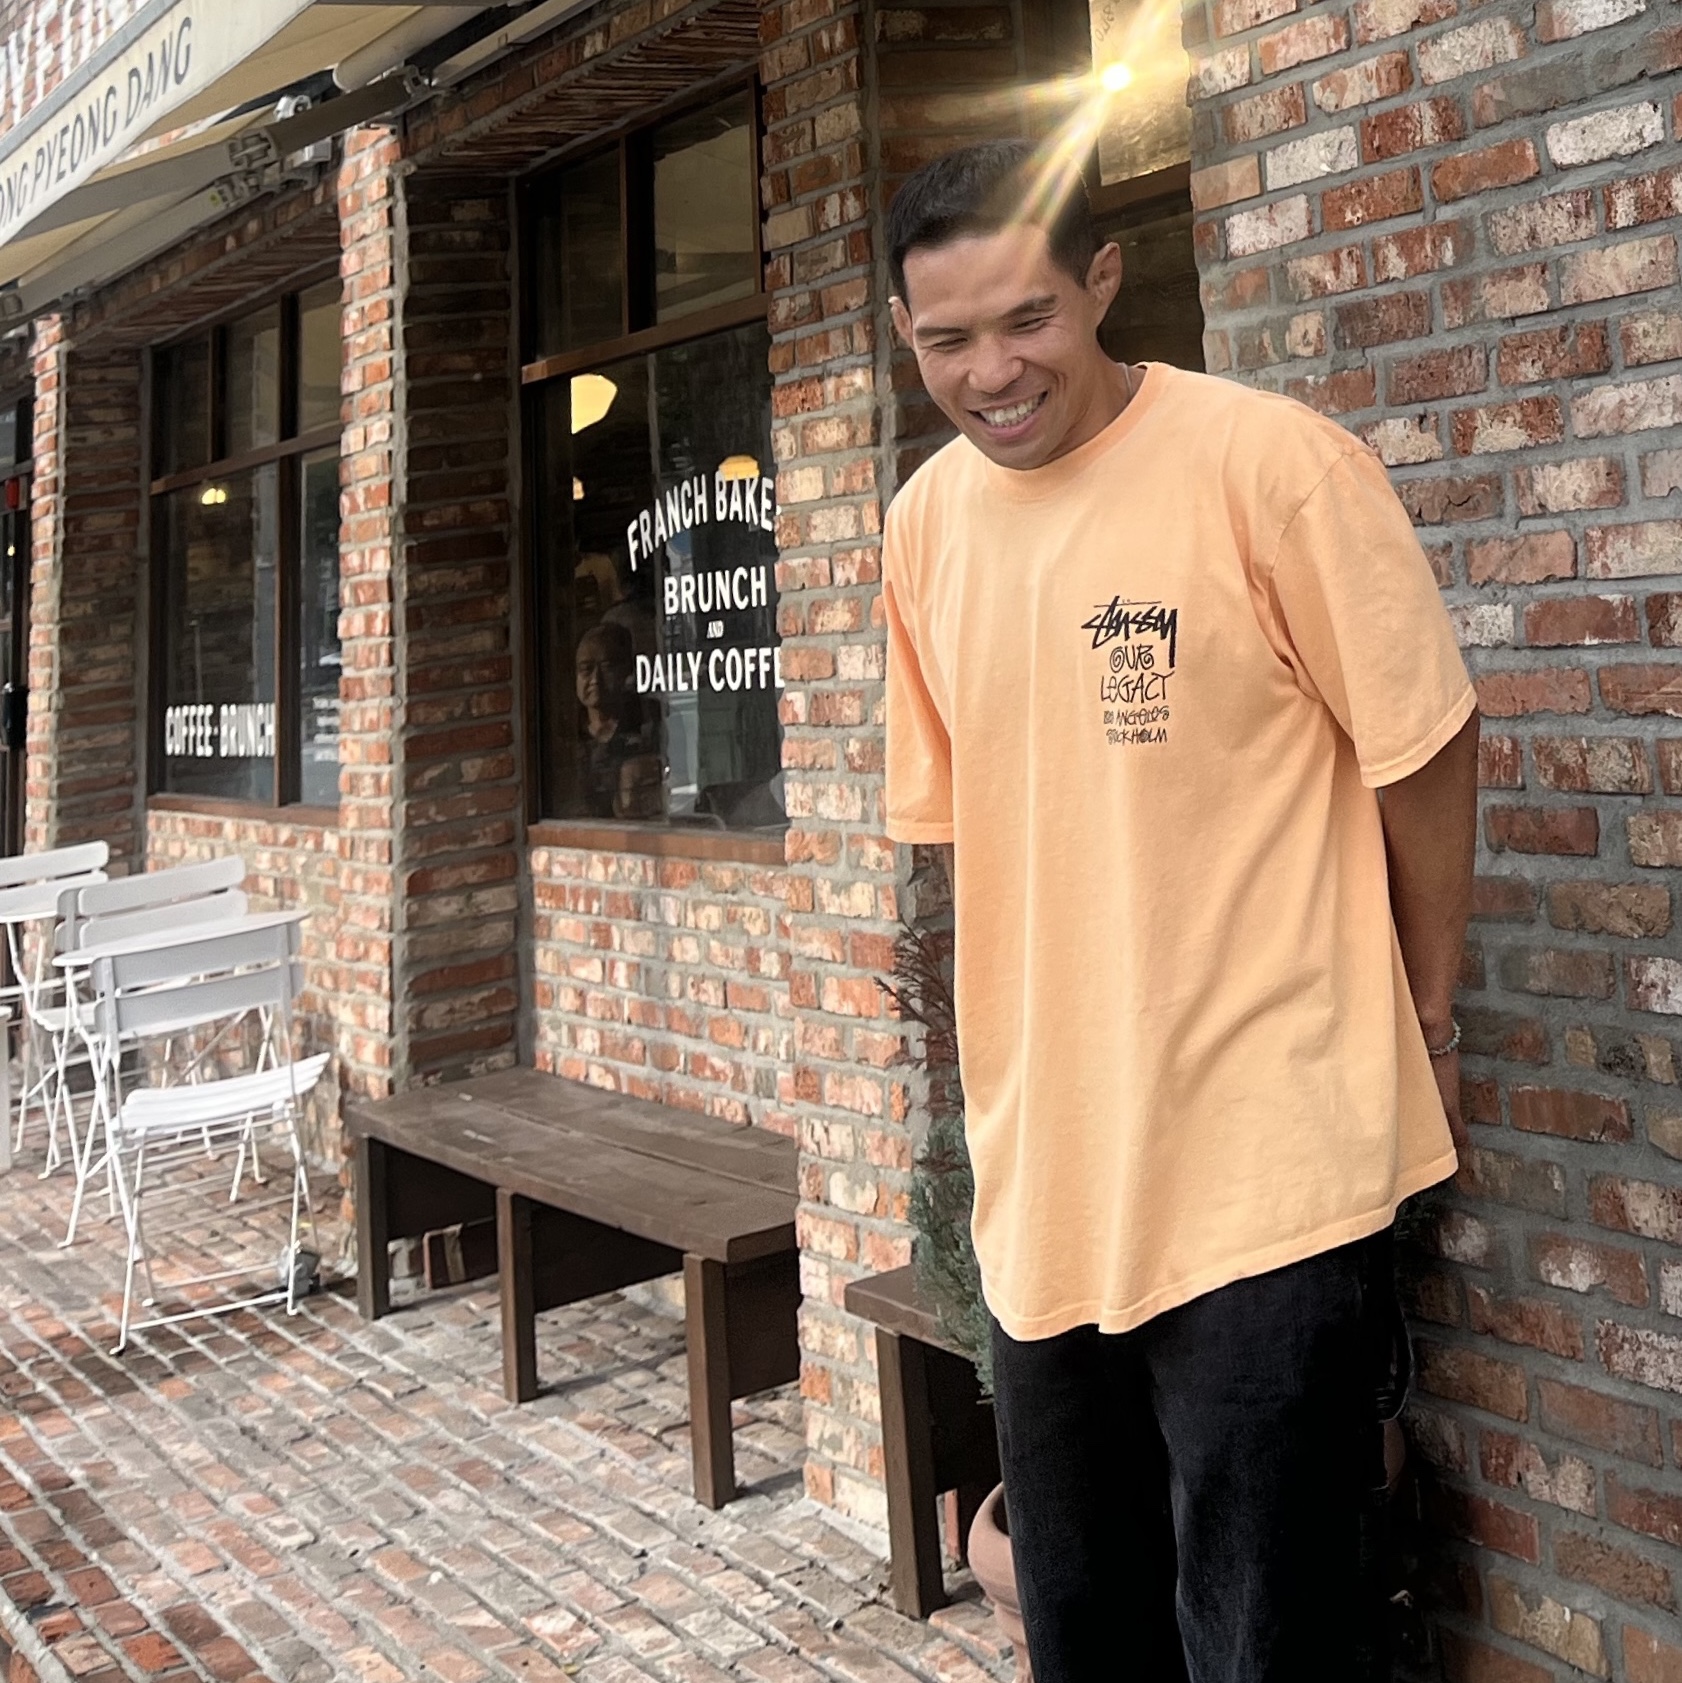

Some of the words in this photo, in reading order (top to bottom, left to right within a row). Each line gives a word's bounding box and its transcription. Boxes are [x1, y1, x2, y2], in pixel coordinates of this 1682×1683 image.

[30, 85, 118, 204] PYEONG
[125, 16, 192, 131] DANG
[627, 473, 708, 572] FRANCH
[714, 471, 781, 532] BAKE
[664, 565, 767, 615] BRUNCH
[707, 620, 724, 638] AND
[636, 651, 702, 693] DAILY
[1109, 643, 1154, 674] OUR
[1101, 671, 1175, 703] LEGACY
